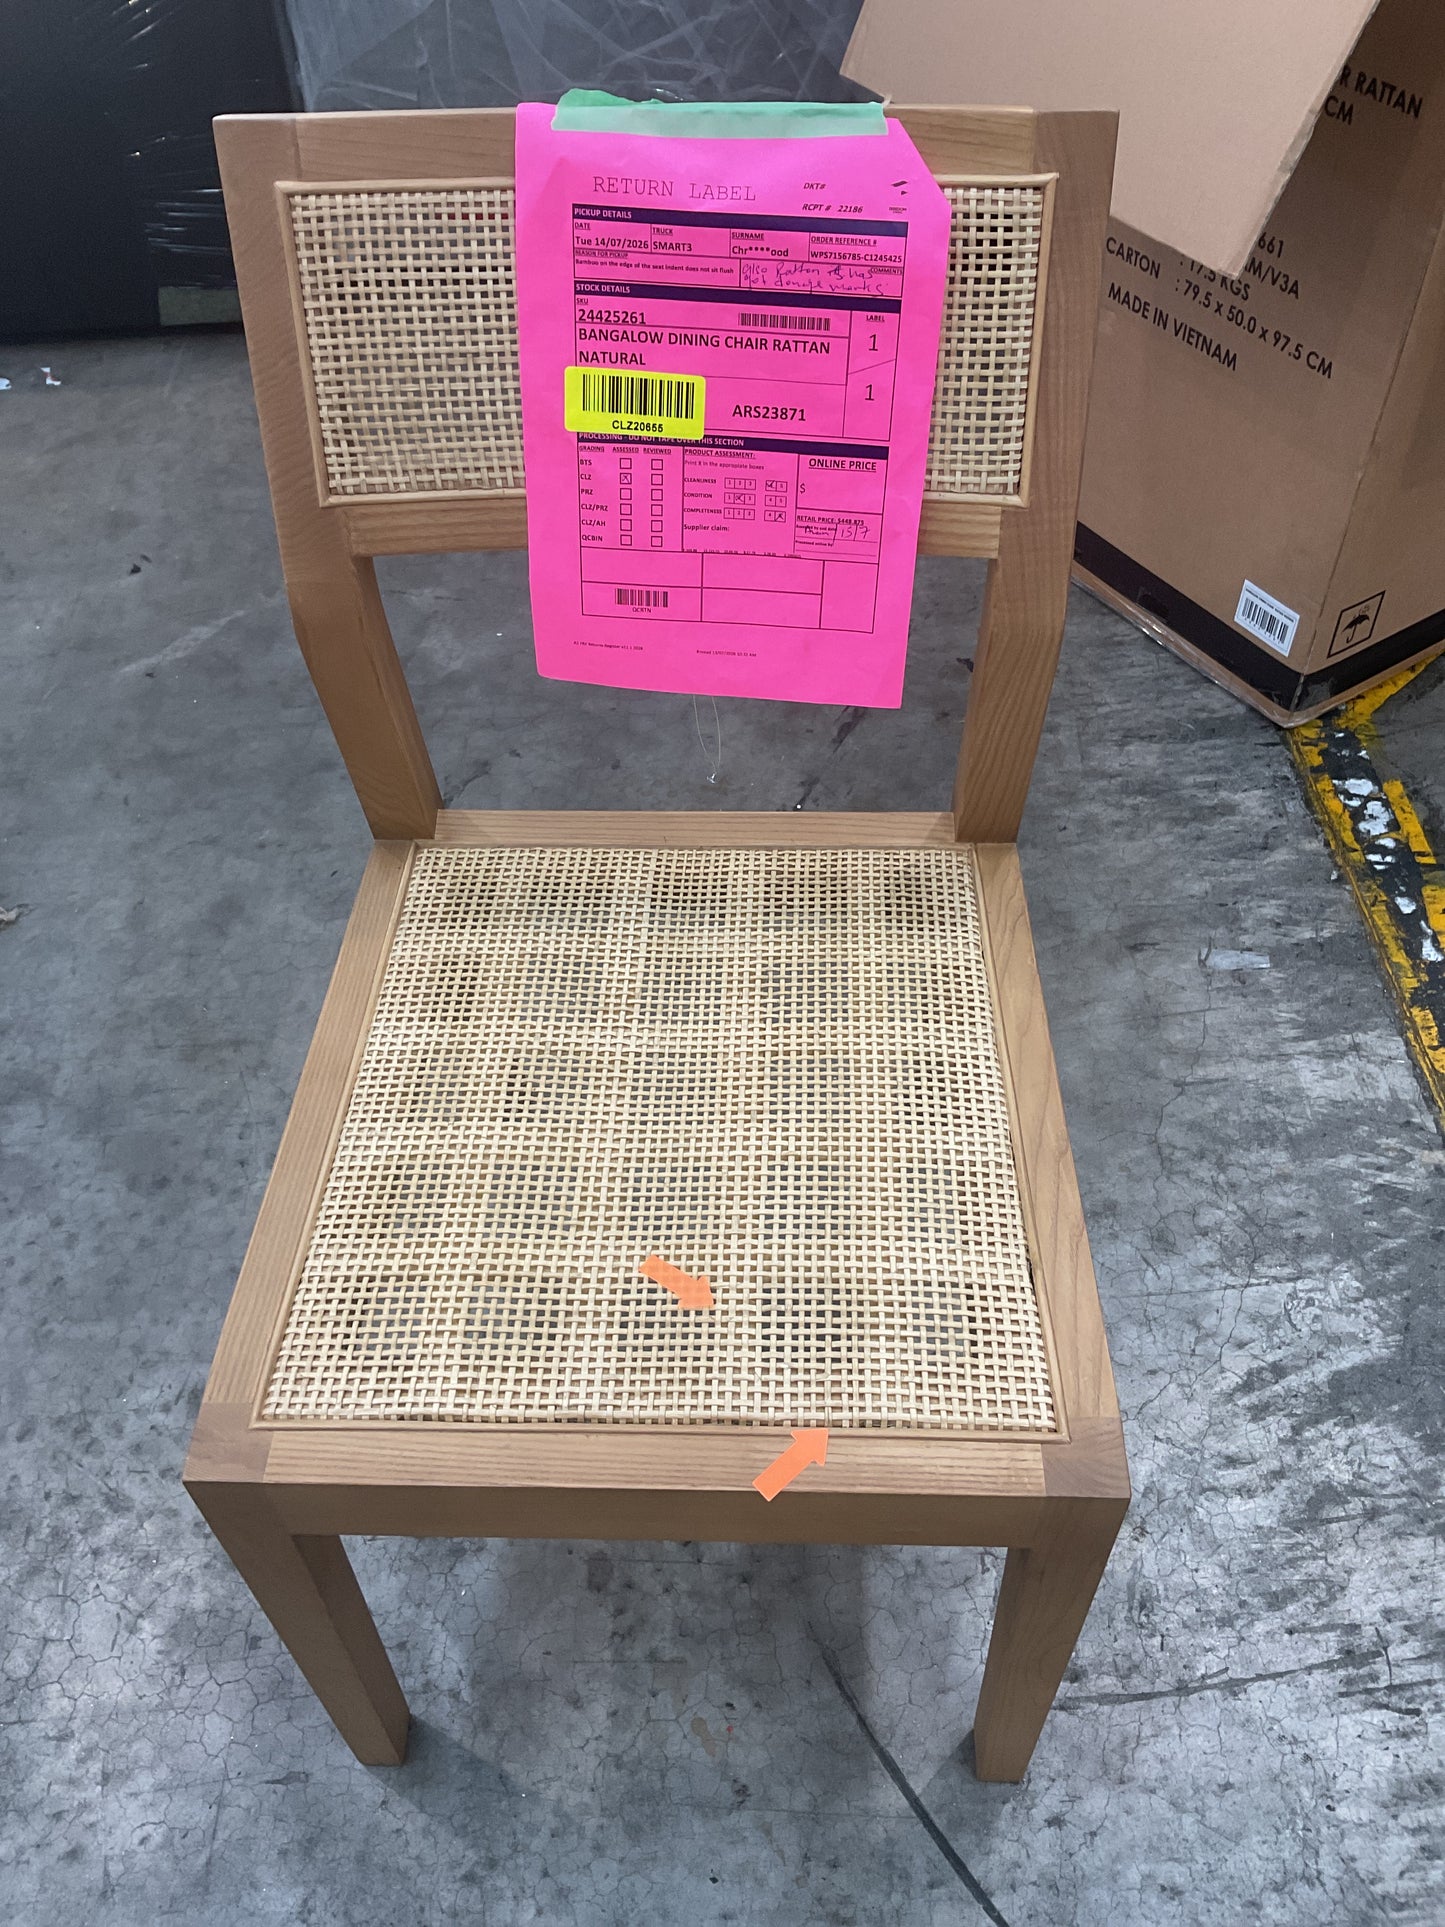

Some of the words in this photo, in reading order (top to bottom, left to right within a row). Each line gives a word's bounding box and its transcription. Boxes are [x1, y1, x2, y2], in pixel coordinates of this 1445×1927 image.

[1355, 72, 1423, 118] RATTAN
[1324, 96, 1354, 125] CM
[593, 176, 673, 196] RETURN
[689, 183, 756, 200] LABEL
[574, 208, 600, 217] PICKUP
[602, 211, 632, 219] DETAILS
[838, 205, 863, 213] 22186
[653, 227, 673, 235] TRUCK
[732, 232, 764, 240] SURNAME
[576, 236, 592, 246] Tue
[594, 238, 649, 249] 14/07/2026
[653, 241, 692, 252] SMART3
[835, 238, 872, 246] REFERENCE
[810, 250, 902, 263] WPS7156785-C1245425
[602, 286, 630, 294] DETAILS
[1220, 276, 1251, 301] KGS
[1106, 237, 1160, 279] CARTON
[1184, 279, 1212, 308] 79.5
[1227, 305, 1256, 334] 50.0
[1273, 331, 1303, 360] 97.5
[1307, 351, 1333, 379] CM
[578, 308, 646, 324] 24425261
[1108, 283, 1150, 320] MADE
[1153, 308, 1169, 330] IN
[1174, 318, 1237, 371] VIETNAM
[579, 328, 664, 344] BANGALOW
[668, 332, 720, 348] DINING
[724, 336, 768, 350] CHAIR
[772, 338, 830, 354] RATTAN
[868, 334, 878, 351] 1
[579, 351, 646, 365] NATURAL
[864, 384, 874, 401] 1
[732, 404, 806, 422] ARS23871
[612, 420, 664, 432] CLZ20655
[579, 432, 622, 441] PROCESSING
[715, 450, 756, 459] ASSESSMENT:
[809, 458, 846, 469] ONLINE
[849, 461, 876, 471] PRICE
[800, 483, 805, 494] $
